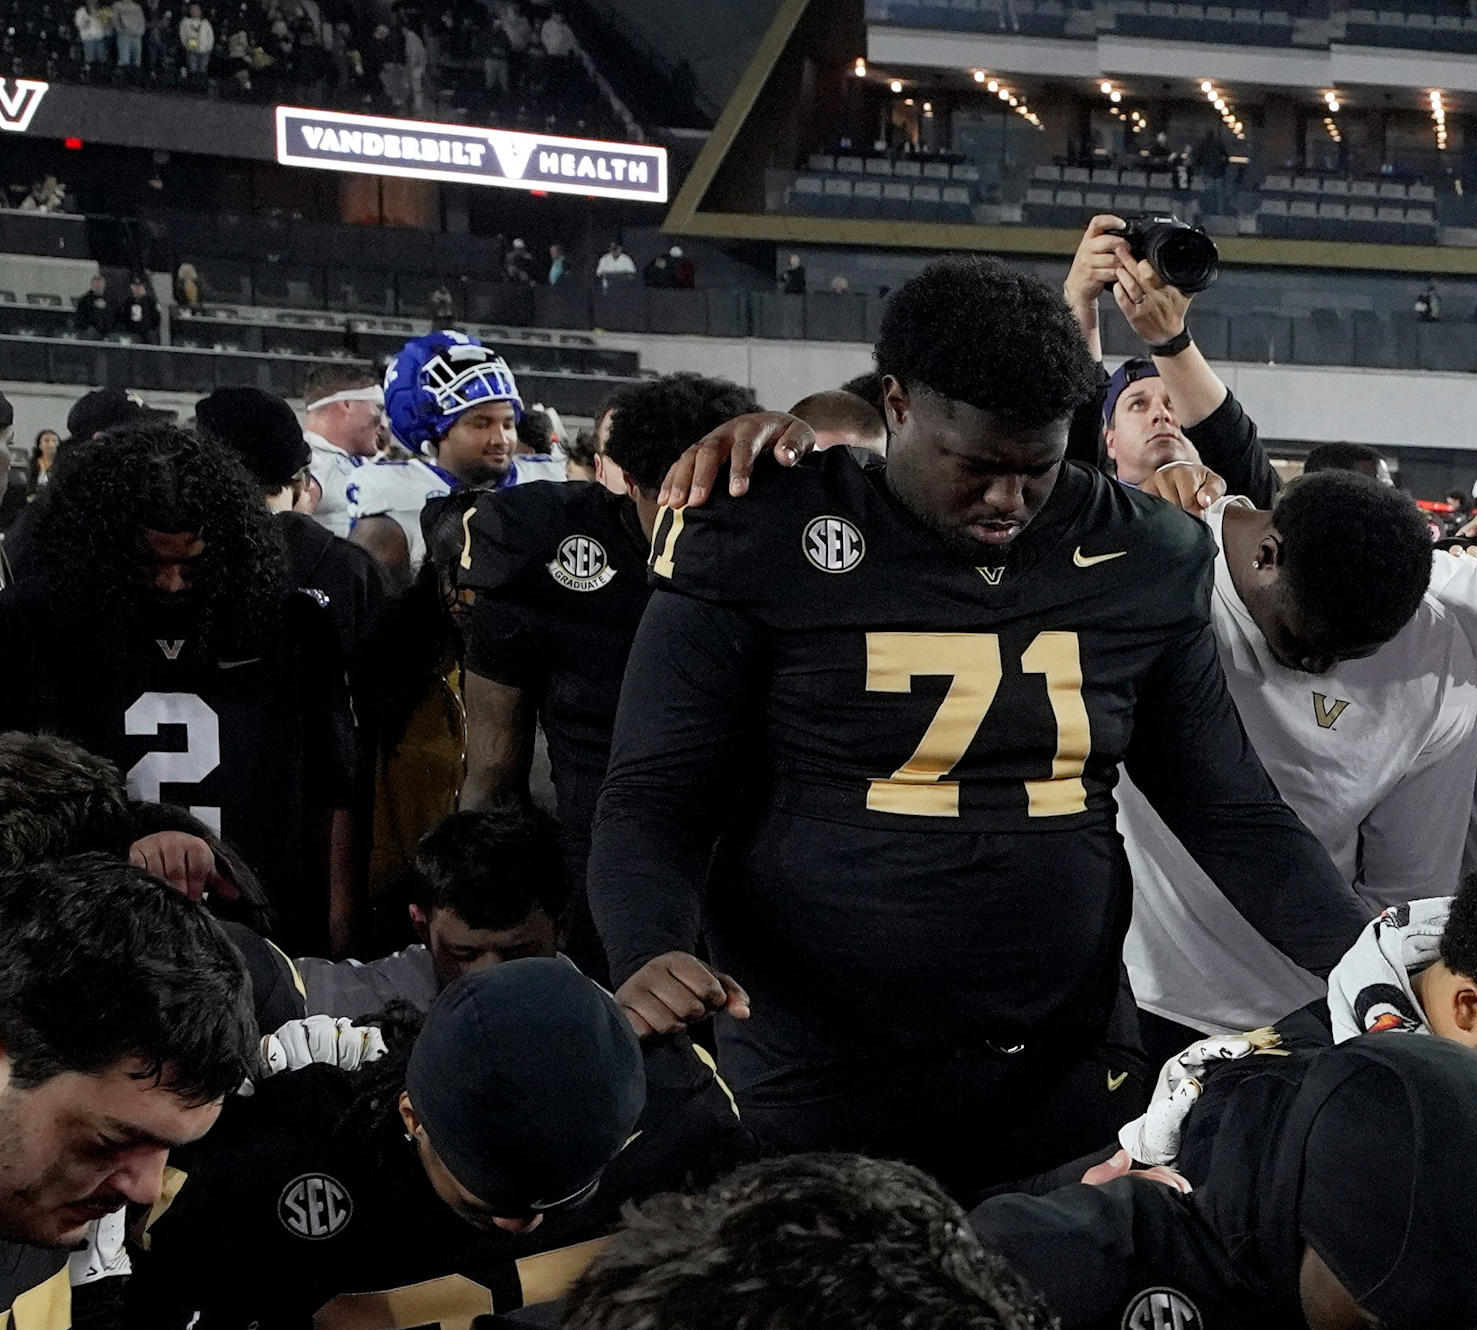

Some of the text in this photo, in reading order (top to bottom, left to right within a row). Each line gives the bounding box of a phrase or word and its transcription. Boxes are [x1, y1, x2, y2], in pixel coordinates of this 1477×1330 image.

[301, 125, 485, 167] VANDERBILT
[539, 151, 649, 183] HEALTH
[562, 538, 602, 577] SEC
[809, 519, 860, 570] SEC
[554, 570, 606, 590] GRADUATE
[865, 631, 1088, 817] 71
[1312, 691, 1350, 731] V
[284, 1177, 348, 1237] SEC
